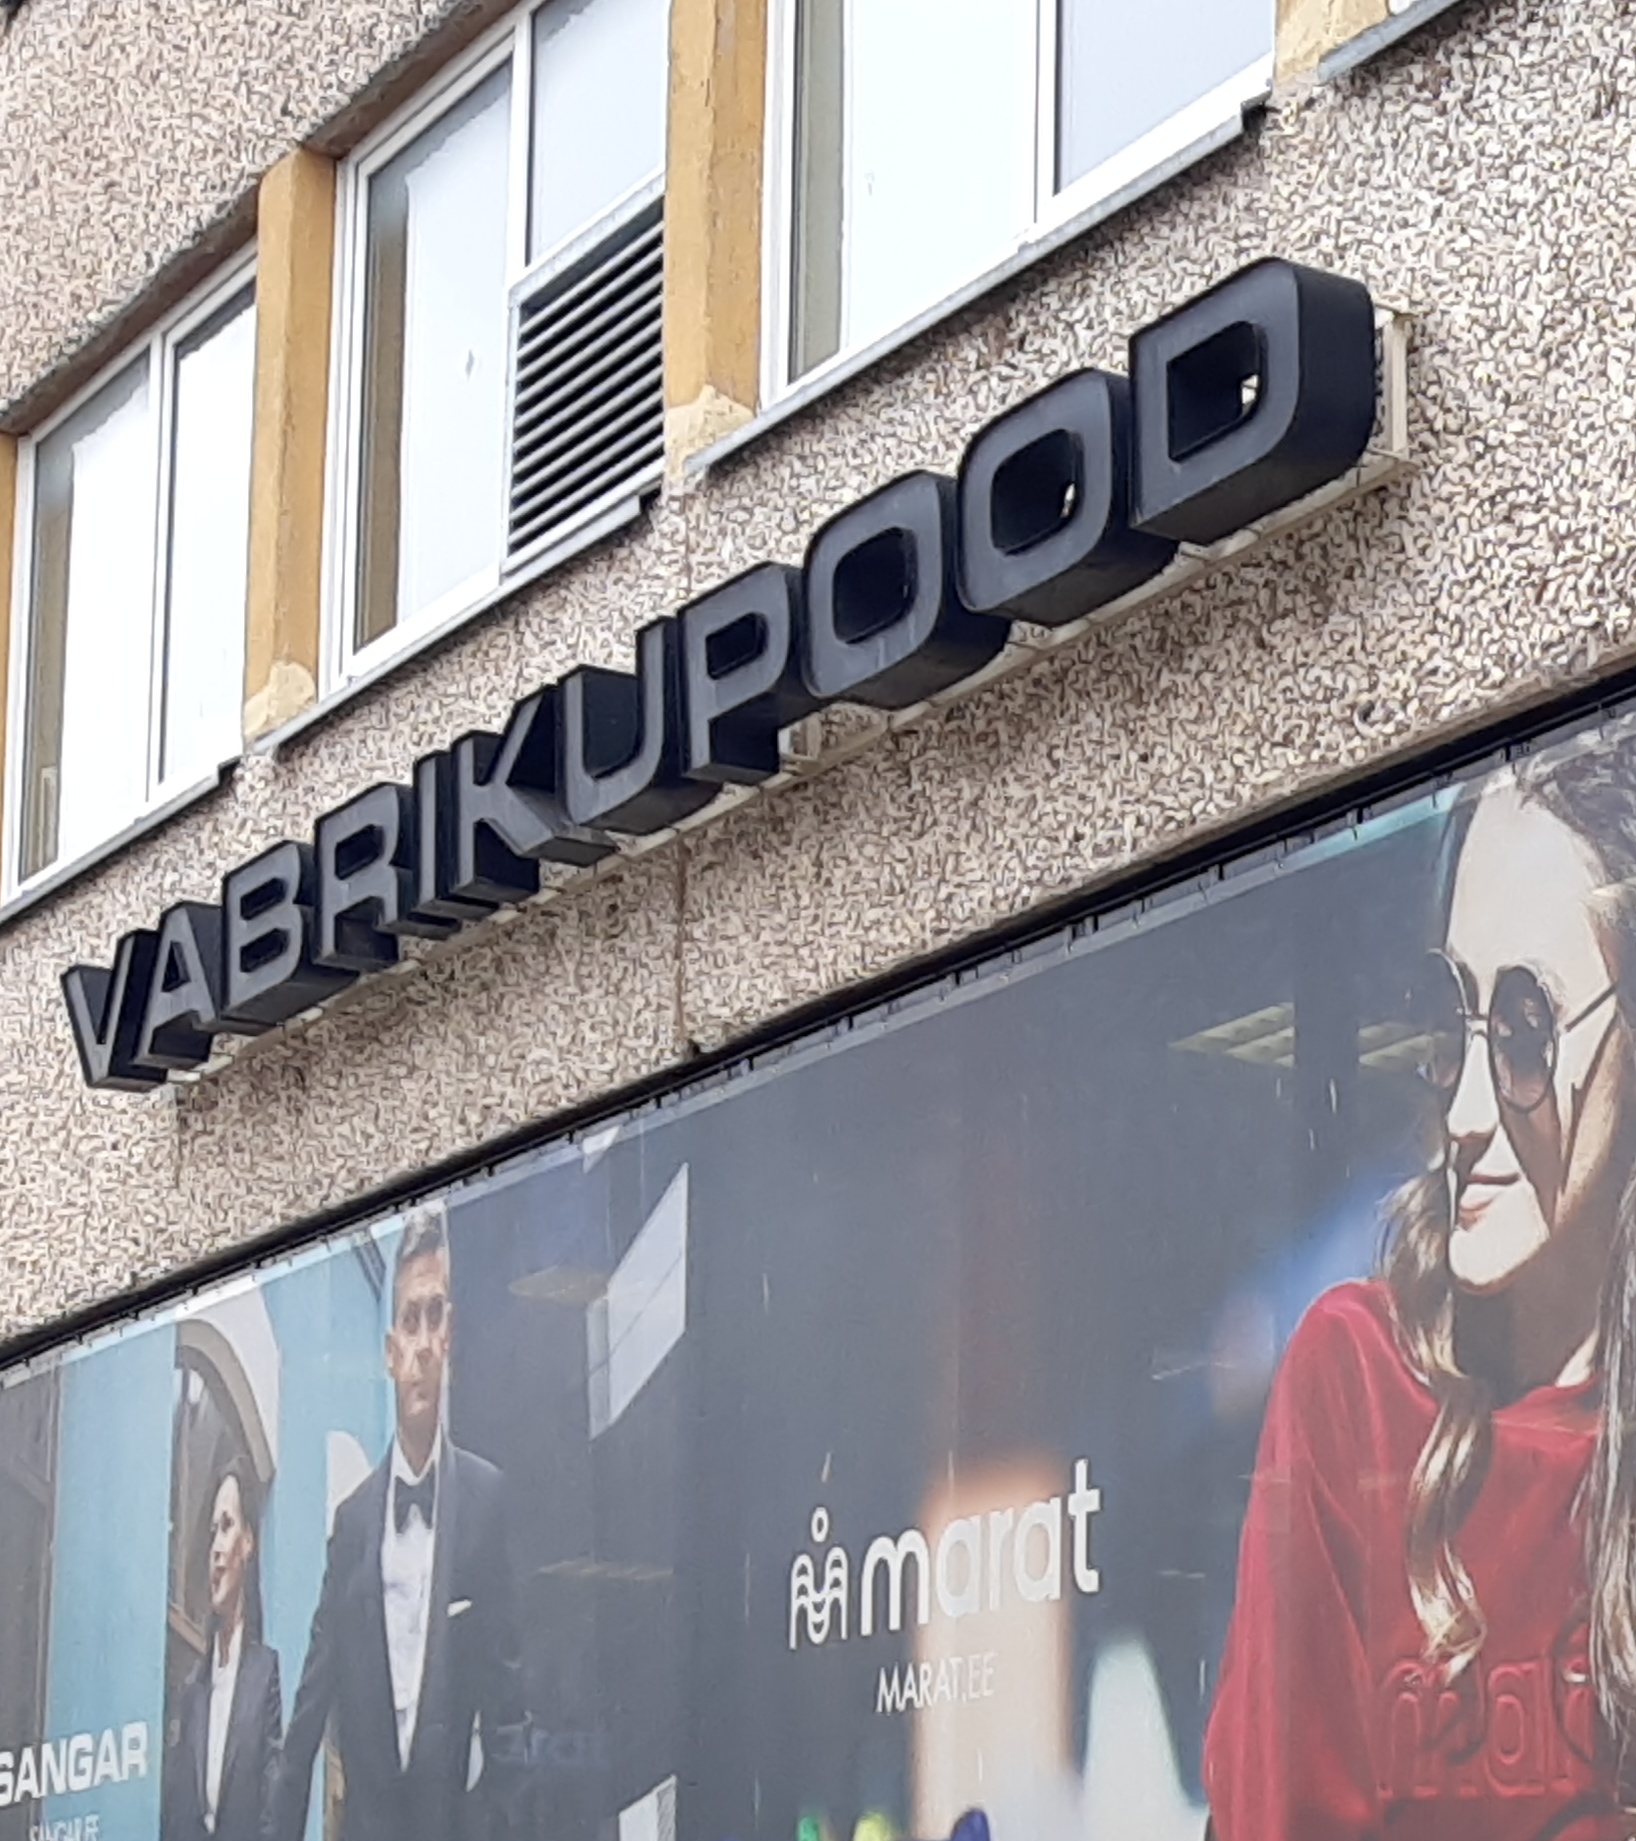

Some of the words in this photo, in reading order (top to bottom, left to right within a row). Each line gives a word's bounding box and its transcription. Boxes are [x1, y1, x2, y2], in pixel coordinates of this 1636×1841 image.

[60, 256, 1376, 1092] VABRIKUPOOD
[860, 1458, 1100, 1637] marat
[875, 1650, 999, 1715] MARAT.EE
[0, 1720, 148, 1808] SANGAR
